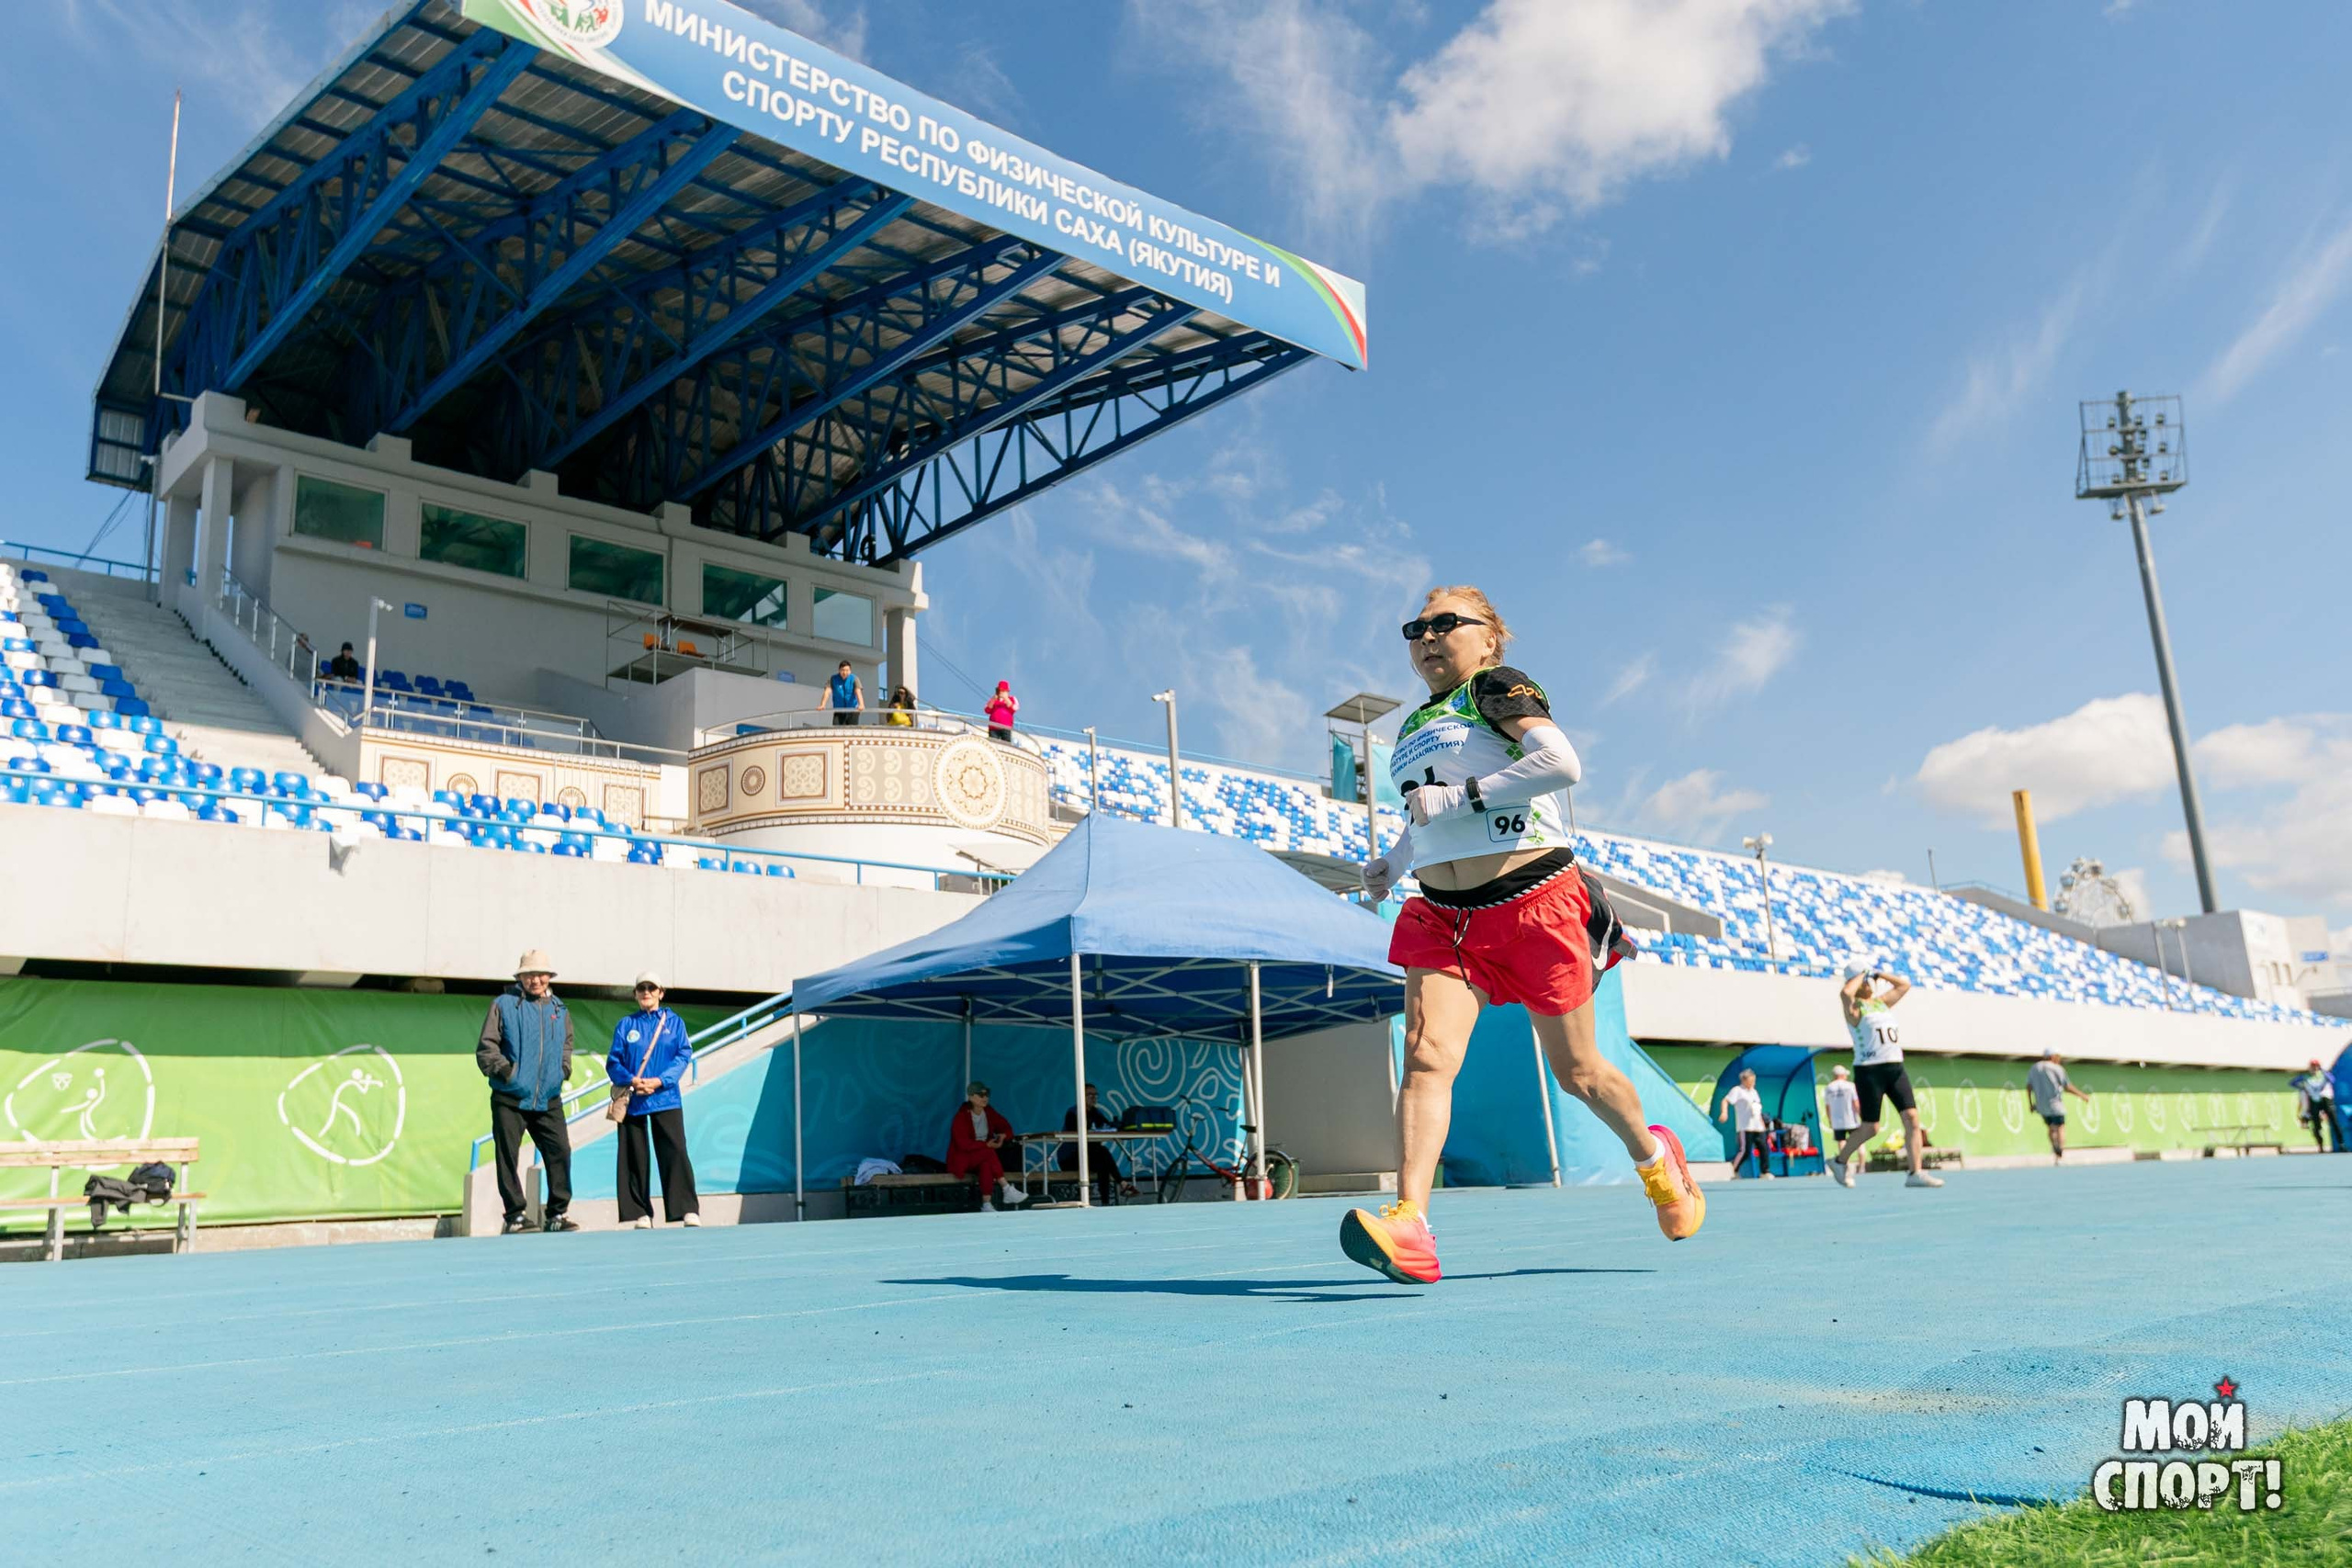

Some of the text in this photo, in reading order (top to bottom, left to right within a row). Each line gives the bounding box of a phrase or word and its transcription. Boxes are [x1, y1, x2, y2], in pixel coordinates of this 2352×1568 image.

[645, 0, 910, 131] МИНИСТЕРСТВО
[919, 115, 960, 153] ПО
[967, 140, 1142, 232] ФИЗИЧЕСКОЙ
[1148, 214, 1261, 279] КУЛЬТУРЕ
[1265, 263, 1281, 288] И
[722, 70, 1234, 305] СПОРТУ РЕСПУБЛИКИ САХА (ЯКУТИЯ)
[1416, 721, 1475, 740] ФИЗИЧЕСКОЙ
[1413, 735, 1441, 751] СПОРТУ
[1494, 814, 1526, 835] 96
